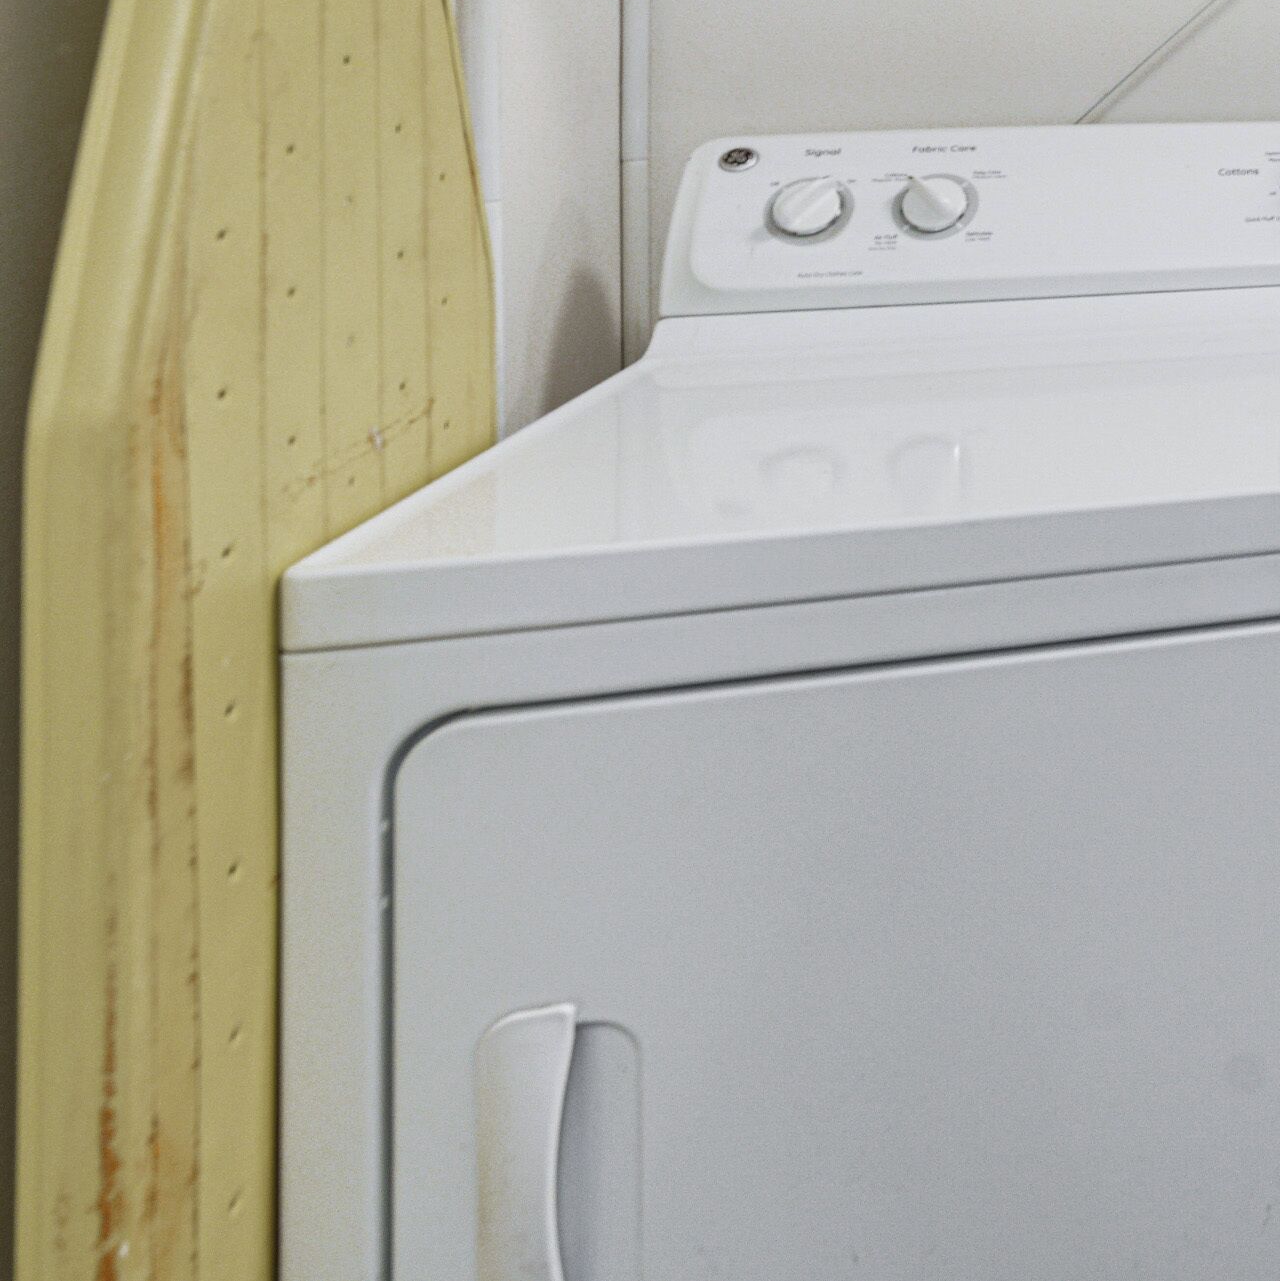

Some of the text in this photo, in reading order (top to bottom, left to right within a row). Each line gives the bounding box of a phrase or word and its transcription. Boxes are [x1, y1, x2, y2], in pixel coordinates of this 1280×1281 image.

[805, 147, 841, 158] Signal
[912, 144, 977, 154] Fabric Care
[1218, 167, 1259, 177] Cottons
